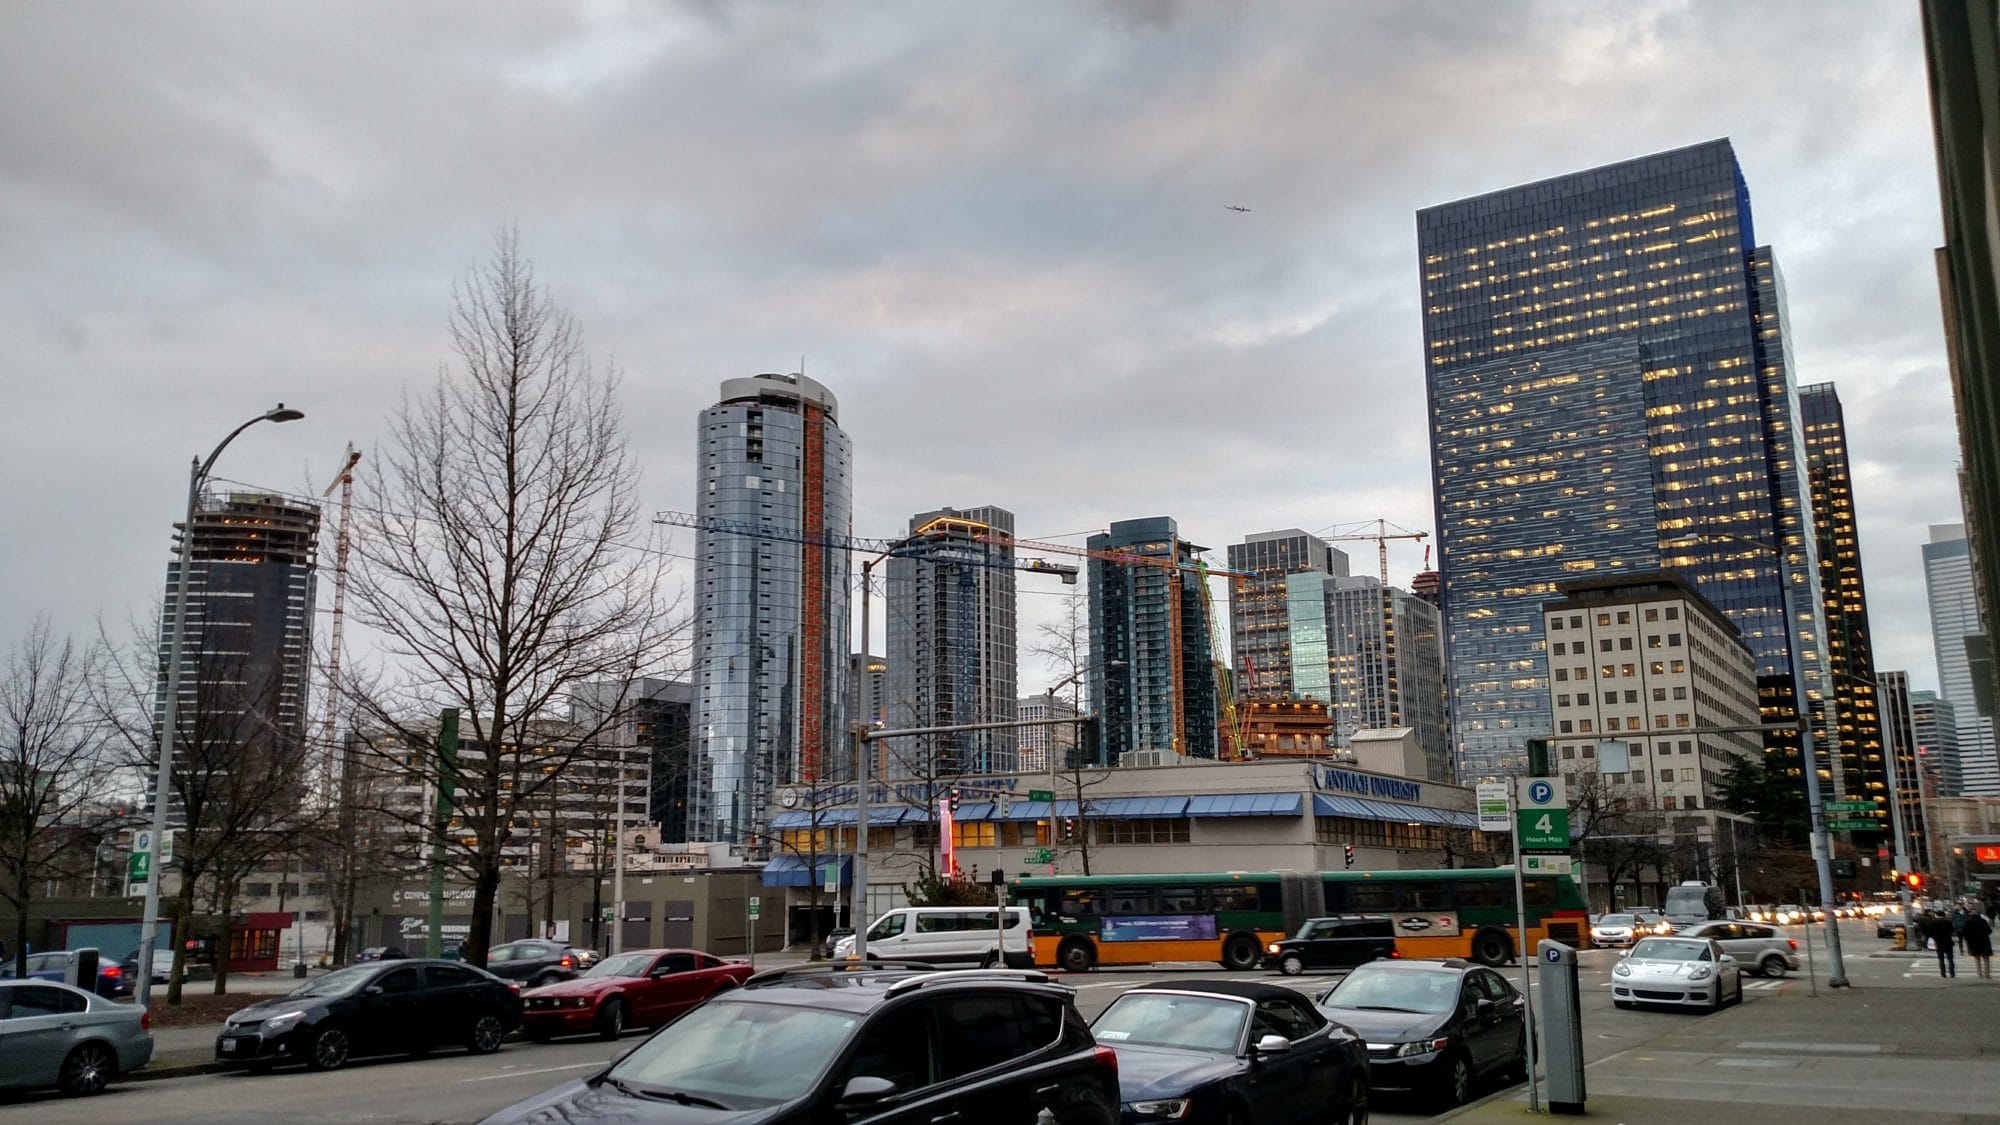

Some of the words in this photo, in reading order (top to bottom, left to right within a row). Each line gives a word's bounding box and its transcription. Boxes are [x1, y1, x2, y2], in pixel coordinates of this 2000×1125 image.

[1325, 769, 1368, 796] ANTIOCH
[1370, 776, 1421, 802] UNIVERSITY
[1535, 785, 1548, 800] P
[1534, 813, 1553, 834] 4
[138, 855, 147, 869] 4
[403, 890, 432, 900] COMPLE
[1549, 950, 1558, 961] P
